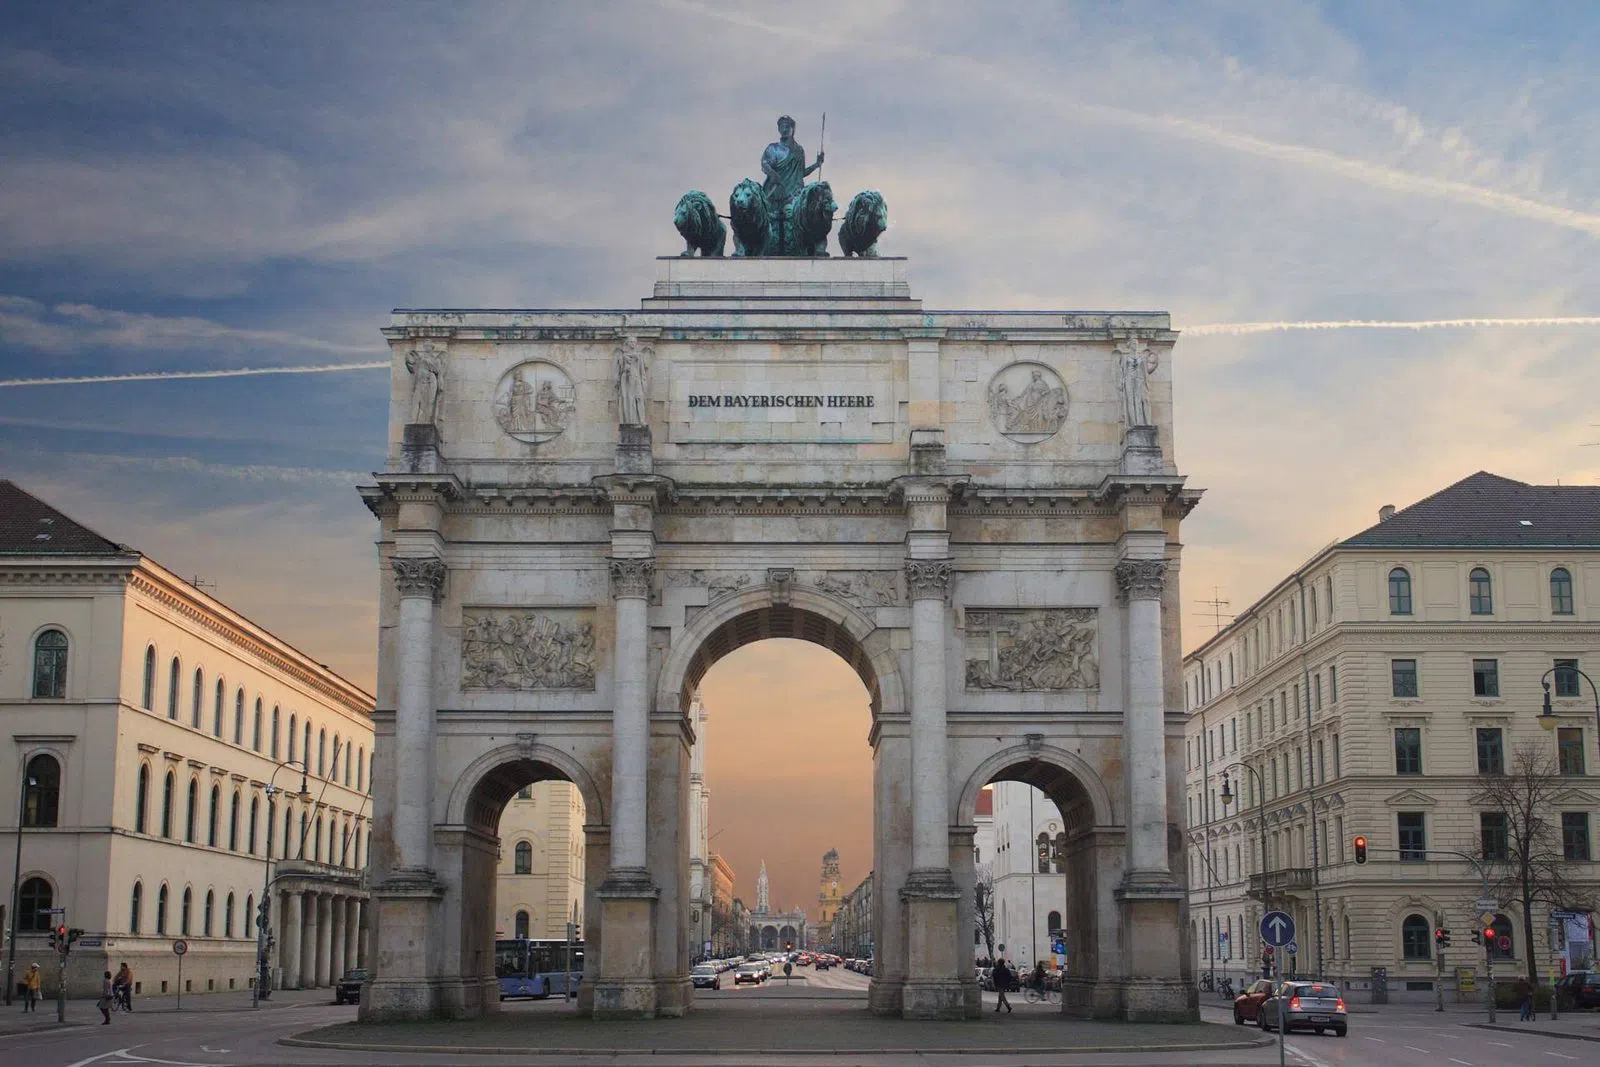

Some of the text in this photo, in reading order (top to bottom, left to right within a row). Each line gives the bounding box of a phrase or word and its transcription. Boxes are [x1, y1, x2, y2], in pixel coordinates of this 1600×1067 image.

[688, 395, 875, 408] DEM BAYERISCHEN HEERE
